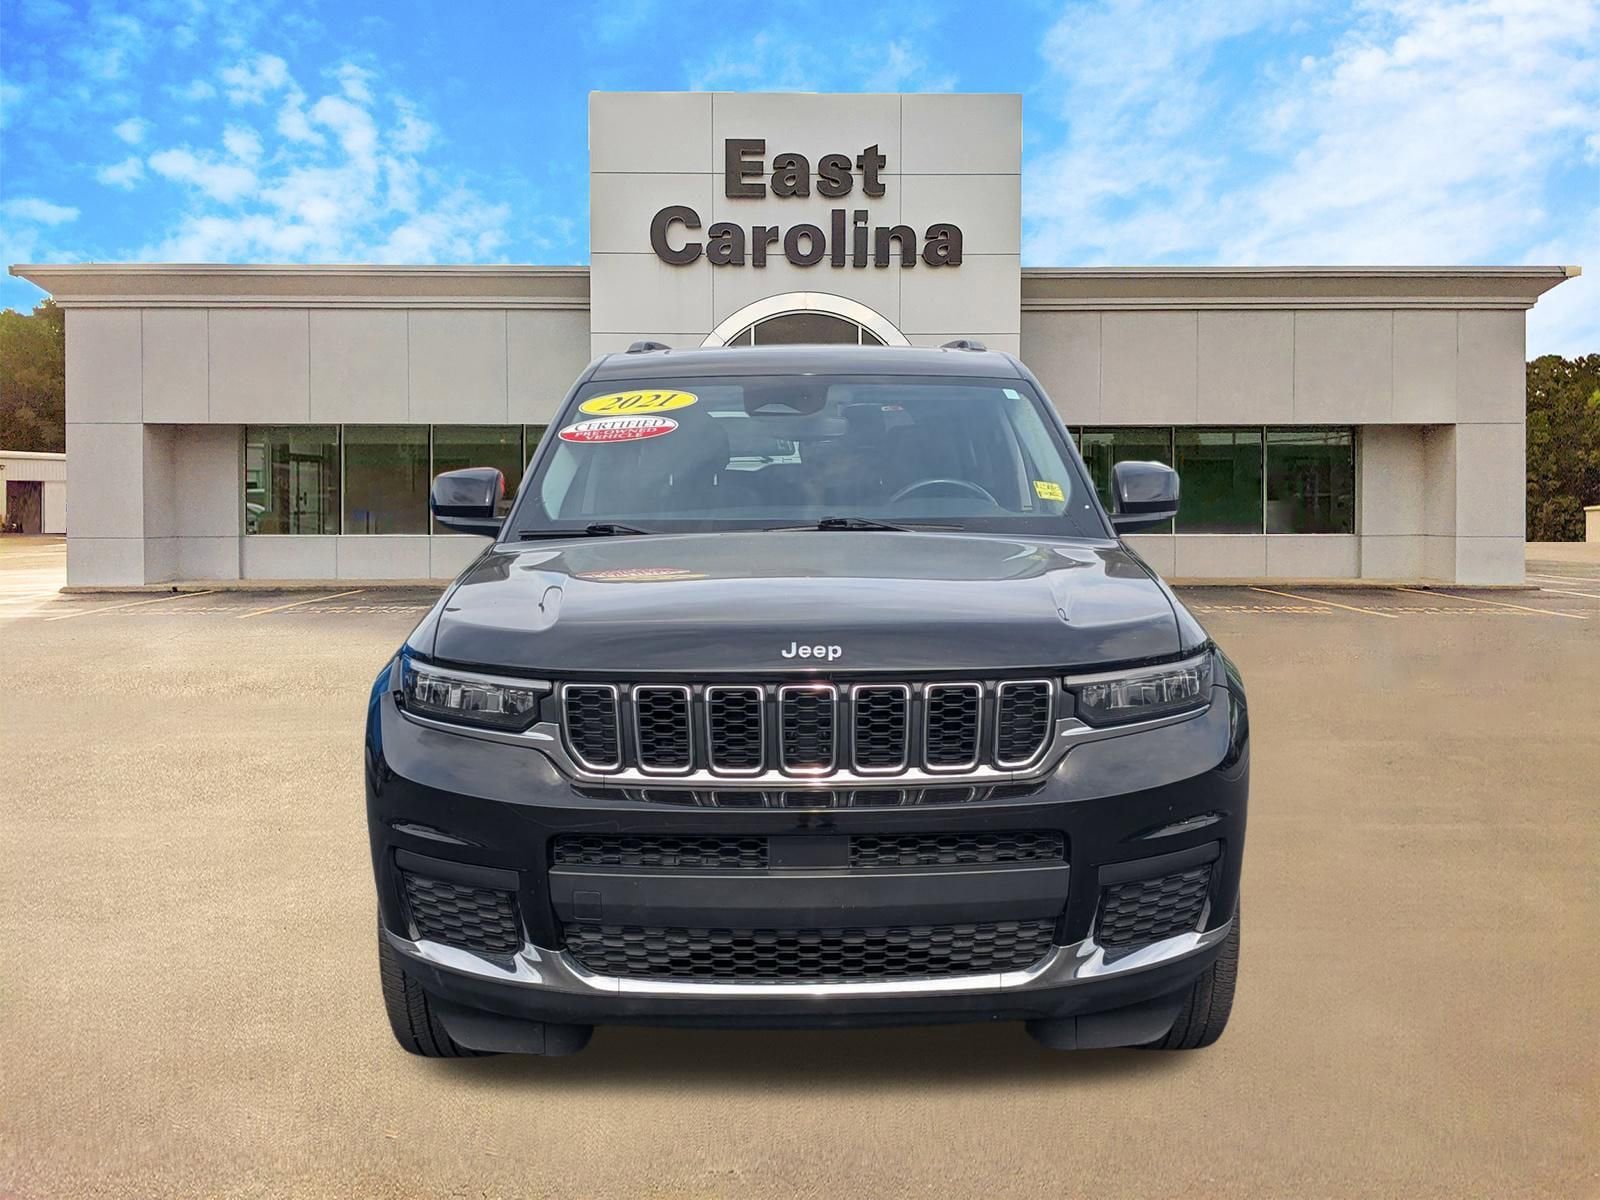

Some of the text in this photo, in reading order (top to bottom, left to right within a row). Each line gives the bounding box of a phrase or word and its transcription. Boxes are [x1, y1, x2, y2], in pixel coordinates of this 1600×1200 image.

[725, 138, 887, 198] East
[650, 205, 963, 267] Carolina
[598, 393, 678, 411] 2021
[574, 417, 666, 431] CERTIFIED
[781, 641, 842, 661] Jeep
